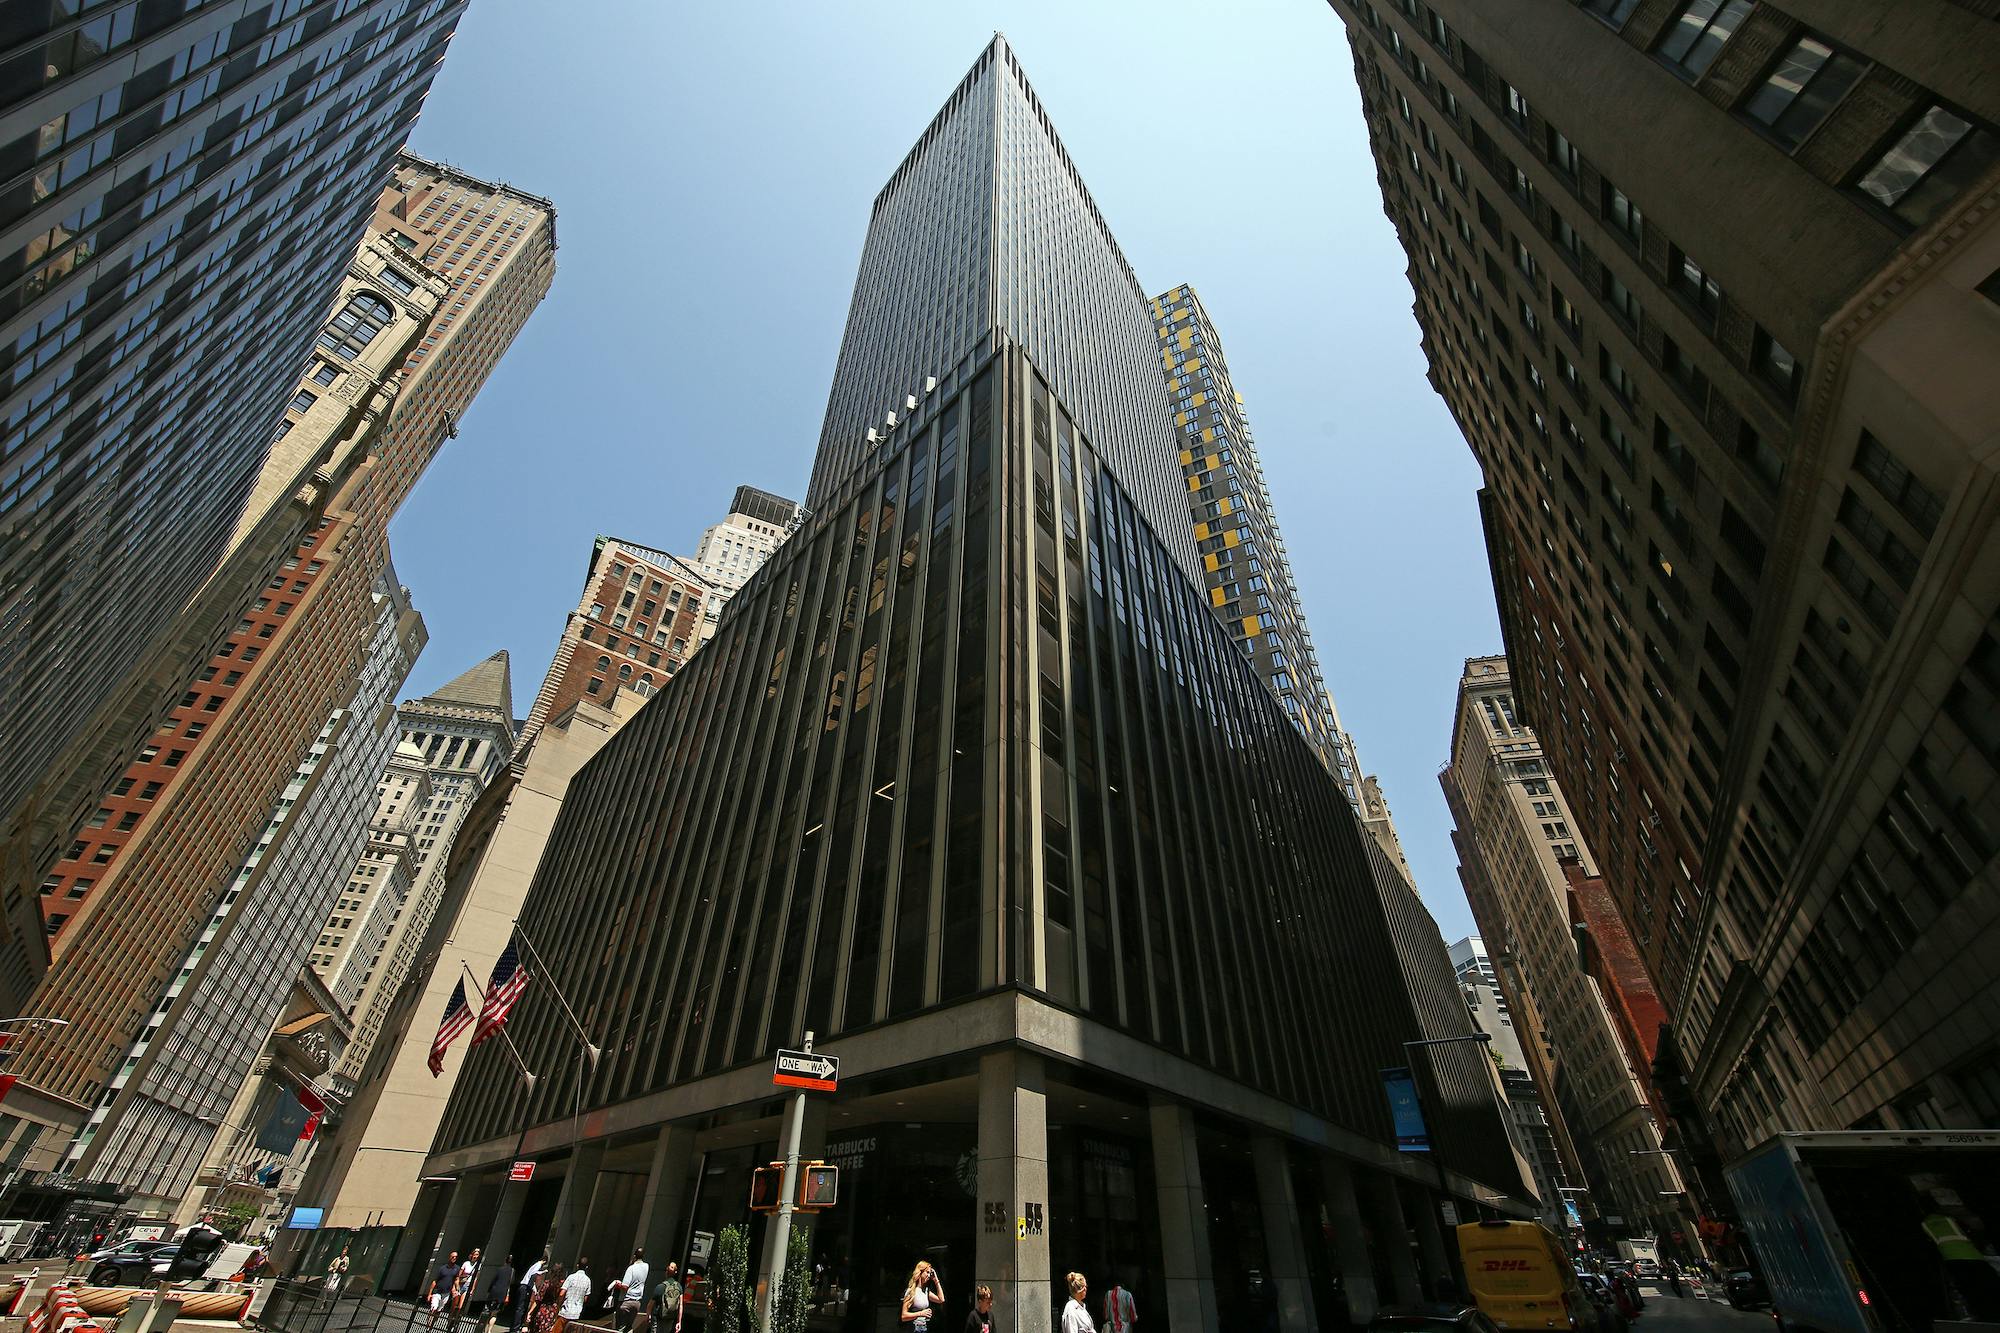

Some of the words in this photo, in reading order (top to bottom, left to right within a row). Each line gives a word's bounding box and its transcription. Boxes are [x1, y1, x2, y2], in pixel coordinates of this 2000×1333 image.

[781, 1058, 800, 1070] ONE
[810, 1062, 829, 1074] WAY
[1945, 1134, 1982, 1143] 25694
[984, 1202, 1007, 1225] 55
[1025, 1202, 1043, 1229] 55
[1483, 1259, 1531, 1272] DHL
